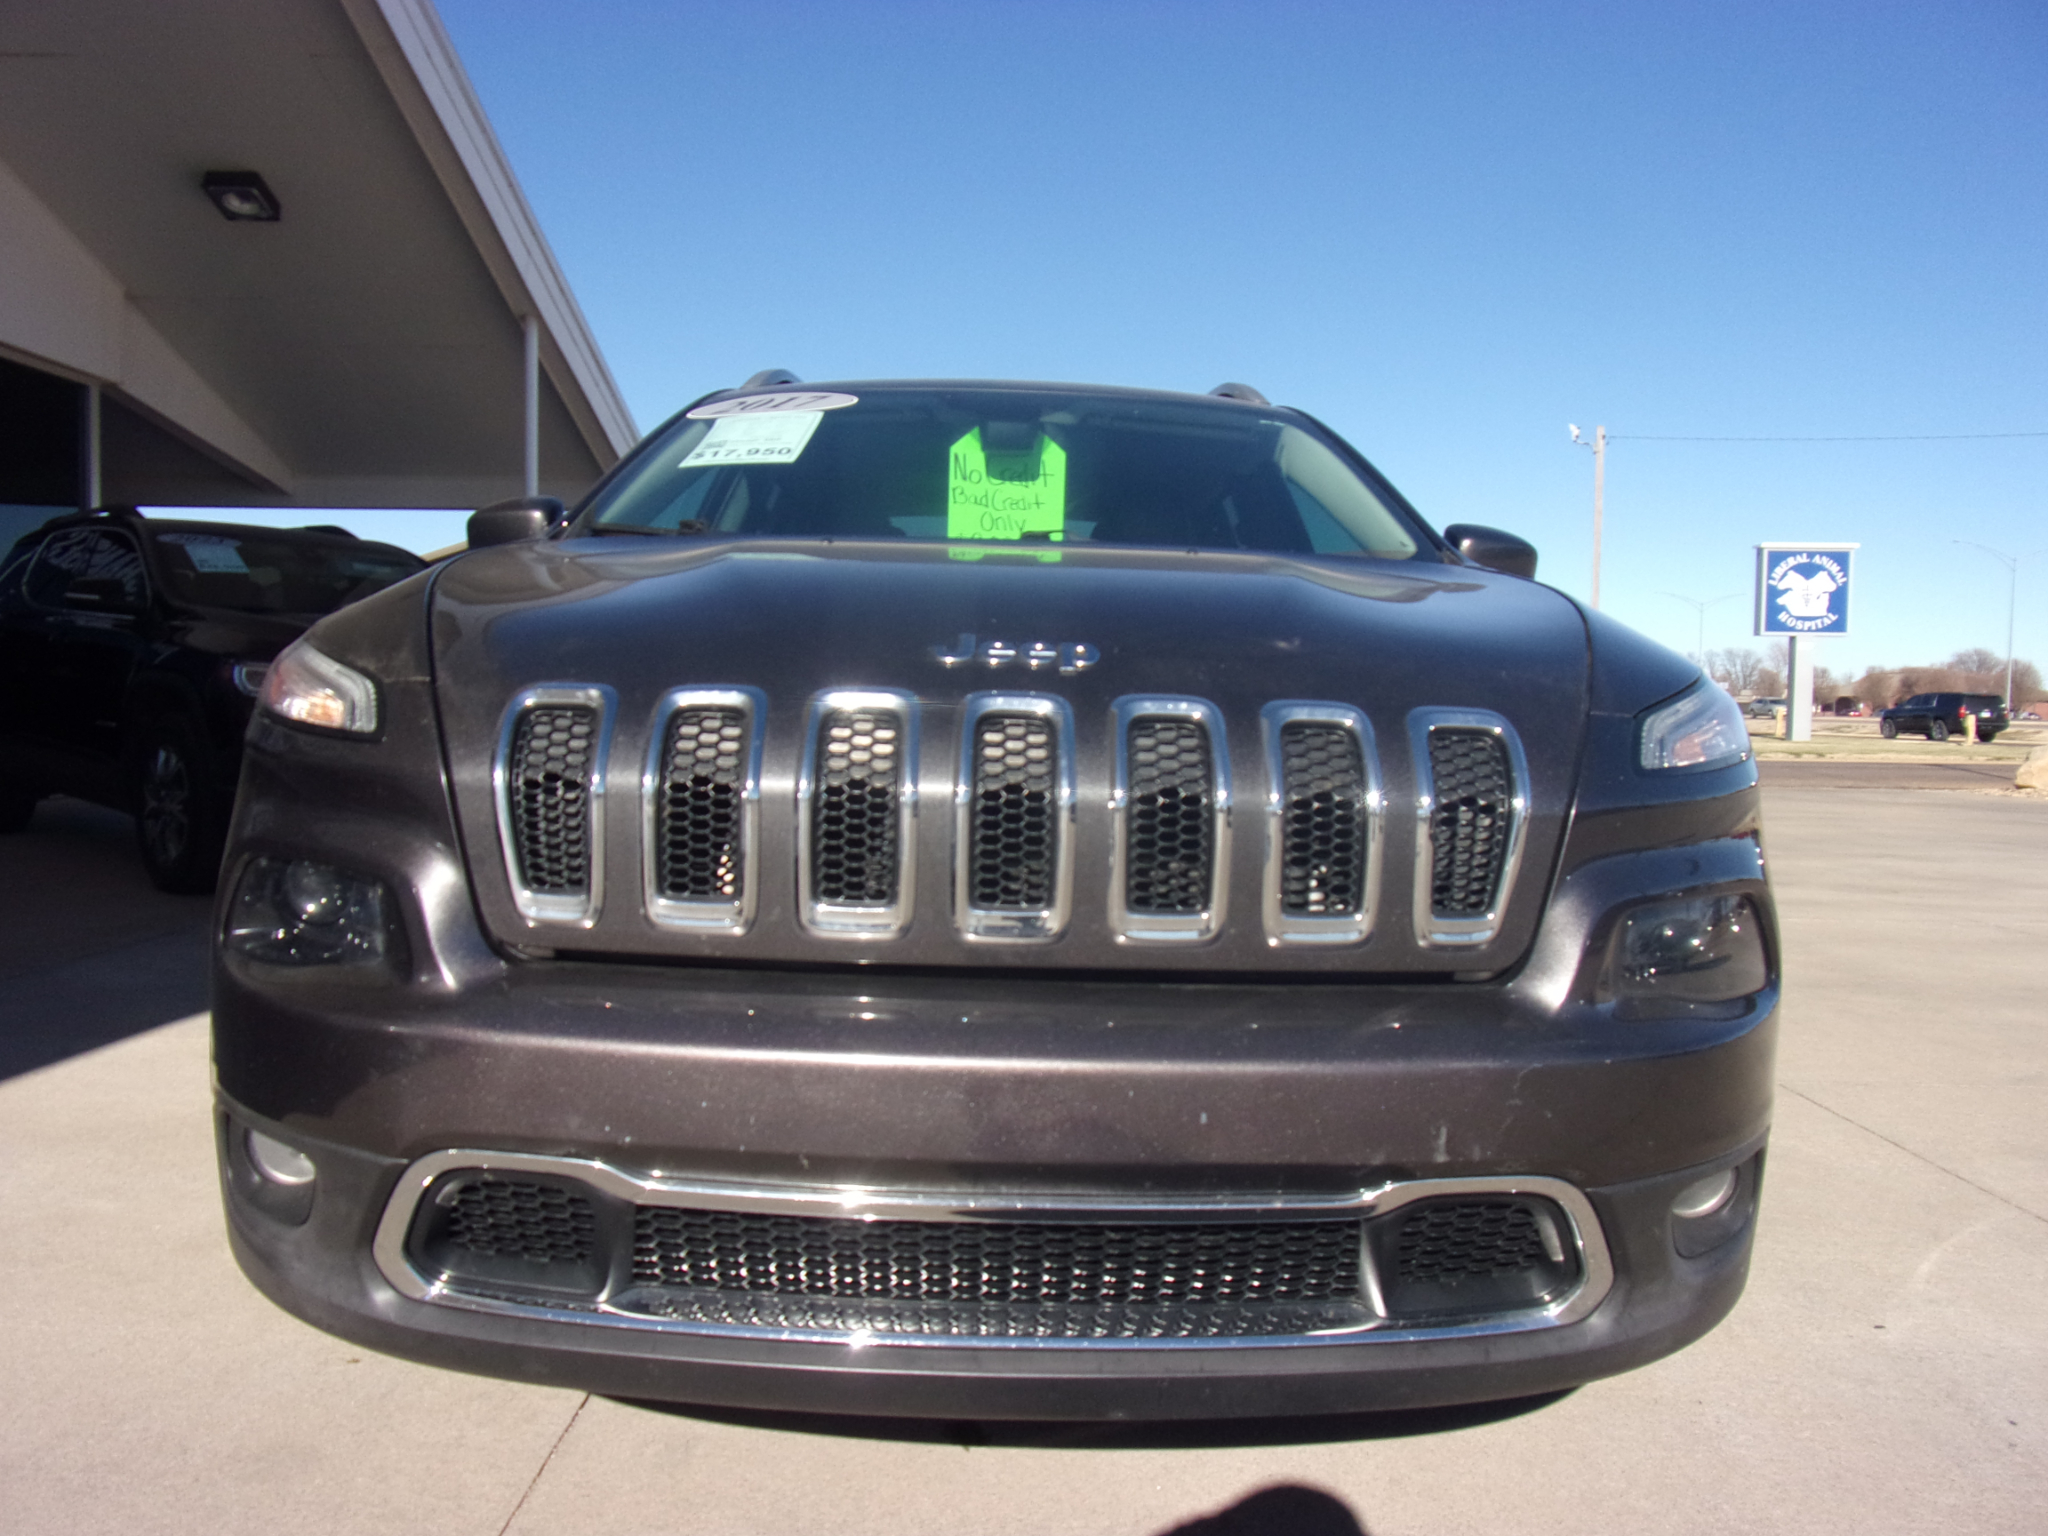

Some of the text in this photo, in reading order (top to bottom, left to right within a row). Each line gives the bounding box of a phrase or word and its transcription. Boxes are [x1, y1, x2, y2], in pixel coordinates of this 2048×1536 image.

[711, 395, 832, 416] 2017
[953, 452, 982, 485] No
[952, 485, 989, 508] Bad
[980, 511, 1026, 532] Only
[1767, 553, 1847, 586] LIBERAL ANIMAL
[1777, 611, 1839, 631] HOSPITAL
[928, 633, 1101, 674] Jeep
